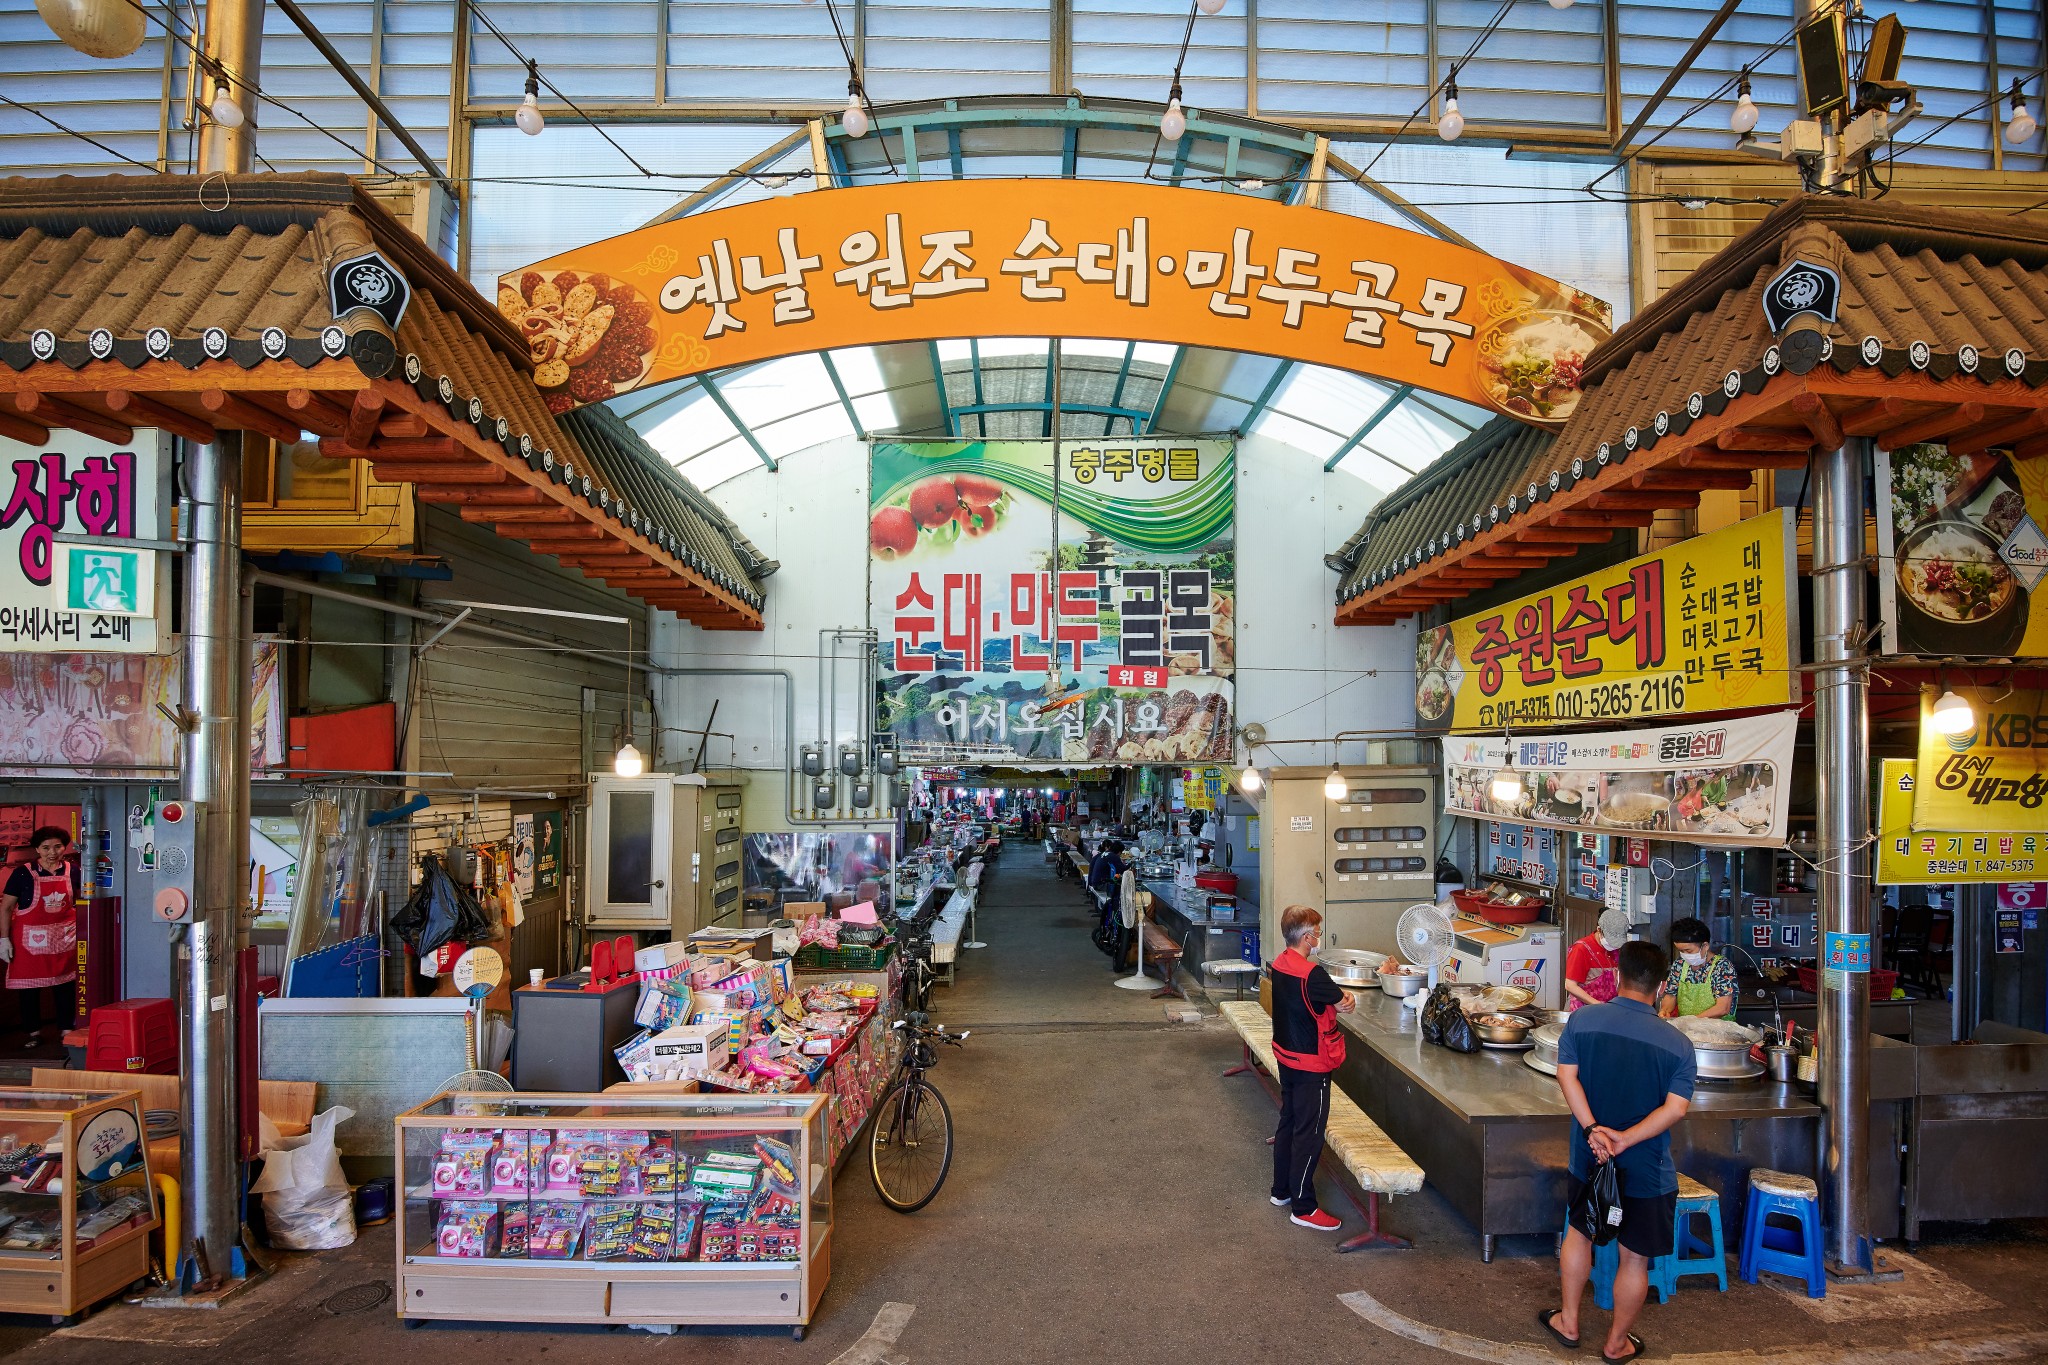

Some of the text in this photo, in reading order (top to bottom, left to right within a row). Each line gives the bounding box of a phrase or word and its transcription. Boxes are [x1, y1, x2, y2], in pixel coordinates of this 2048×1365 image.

[659, 227, 822, 339] 옛날
[834, 213, 989, 311] 원조
[1070, 447, 1199, 485] 충주명물
[1680, 575, 1762, 621] 순대국밥
[1, 607, 131, 643] 악세사리 소매
[1118, 569, 1213, 675] 골목
[1470, 558, 1666, 697] 중원순대
[1682, 610, 1763, 651] 머릿고기
[1684, 647, 1764, 684] 만두국
[1555, 674, 1685, 718] 010-5265-2116
[936, 698, 1169, 740] 어서오십시요
[1985, 713, 2048, 749] KBS
[1660, 731, 1724, 760] 중원순대
[1935, 753, 1995, 790] 6시
[1927, 859, 1968, 873] 중원순대
[1986, 859, 2034, 873] 847-5375
[78, 966, 87, 1016] 도시가스관
[1512, 976, 1536, 986] 해태
